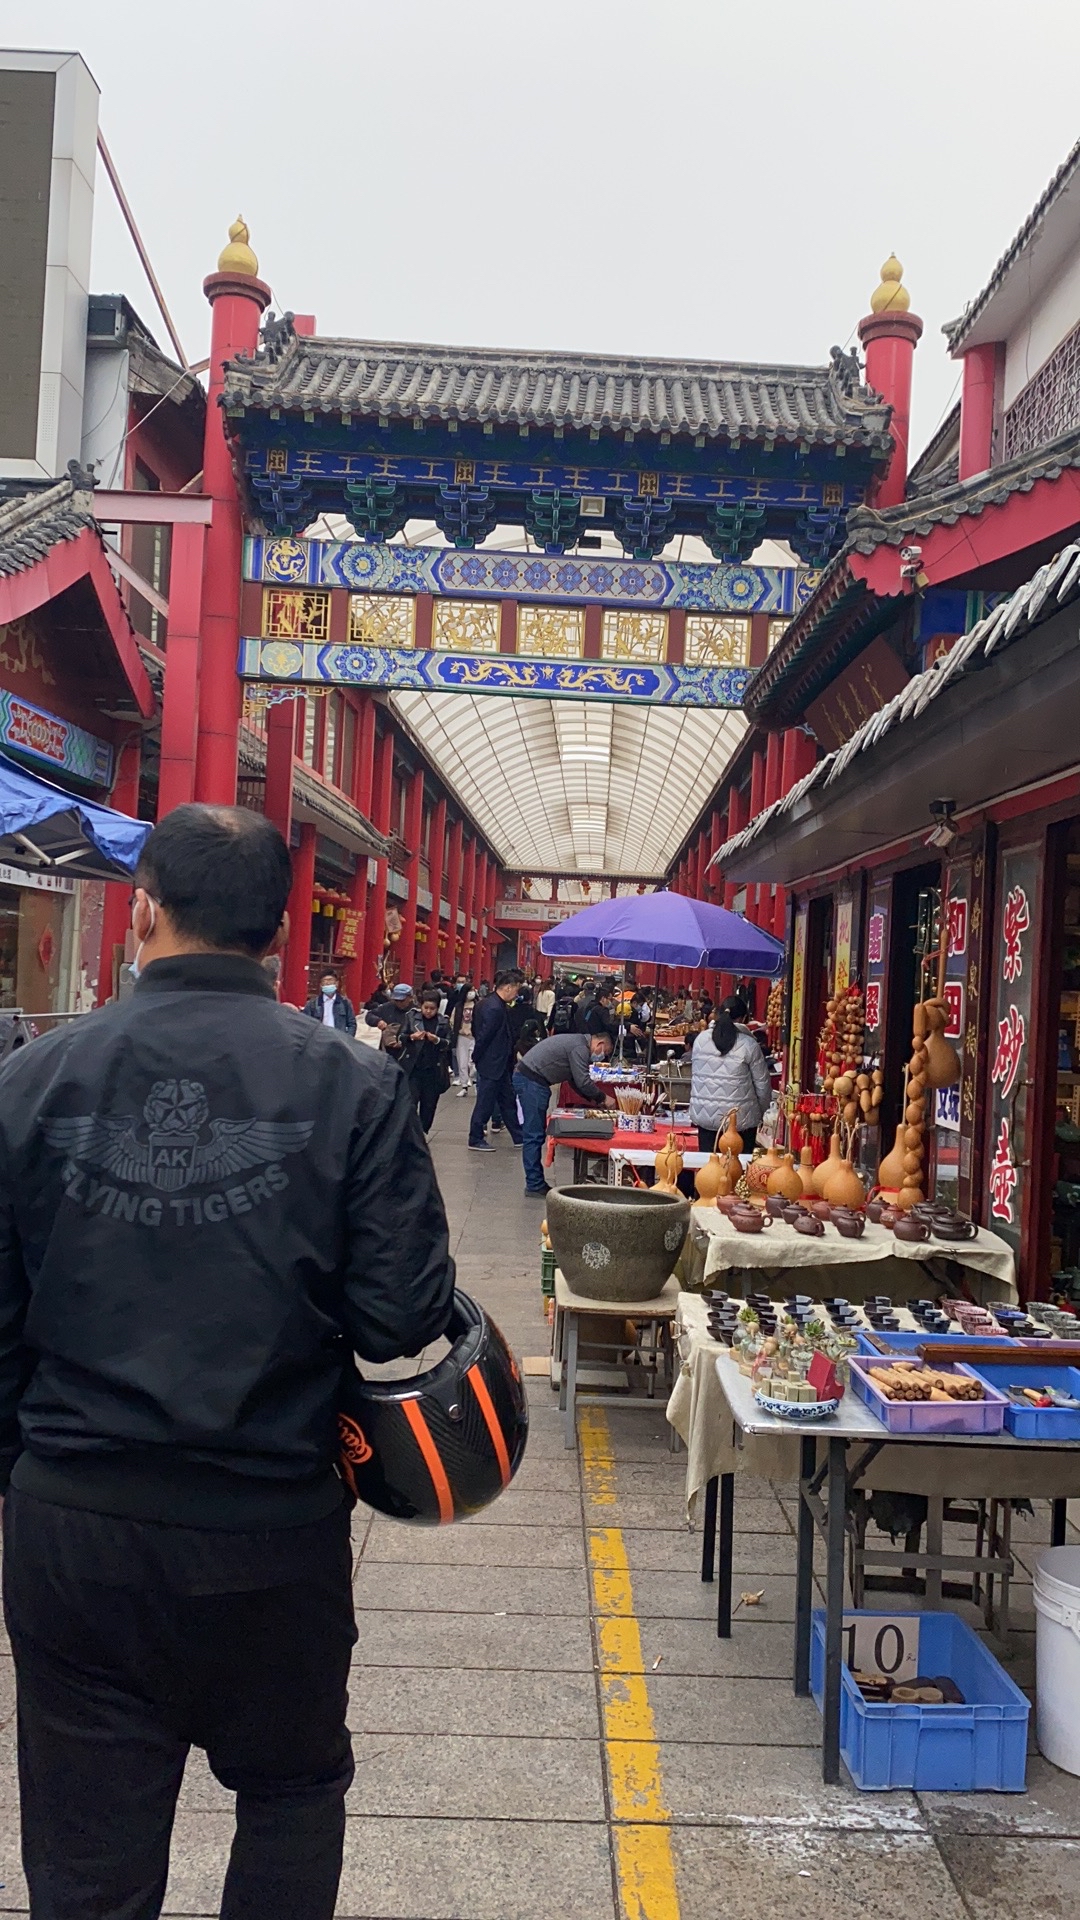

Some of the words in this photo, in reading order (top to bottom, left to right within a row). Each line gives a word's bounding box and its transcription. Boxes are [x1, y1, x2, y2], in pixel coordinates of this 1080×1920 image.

[866, 913, 883, 1032] 翡翠
[153, 1148, 189, 1167] AK
[169, 1163, 290, 1227] TIGERS
